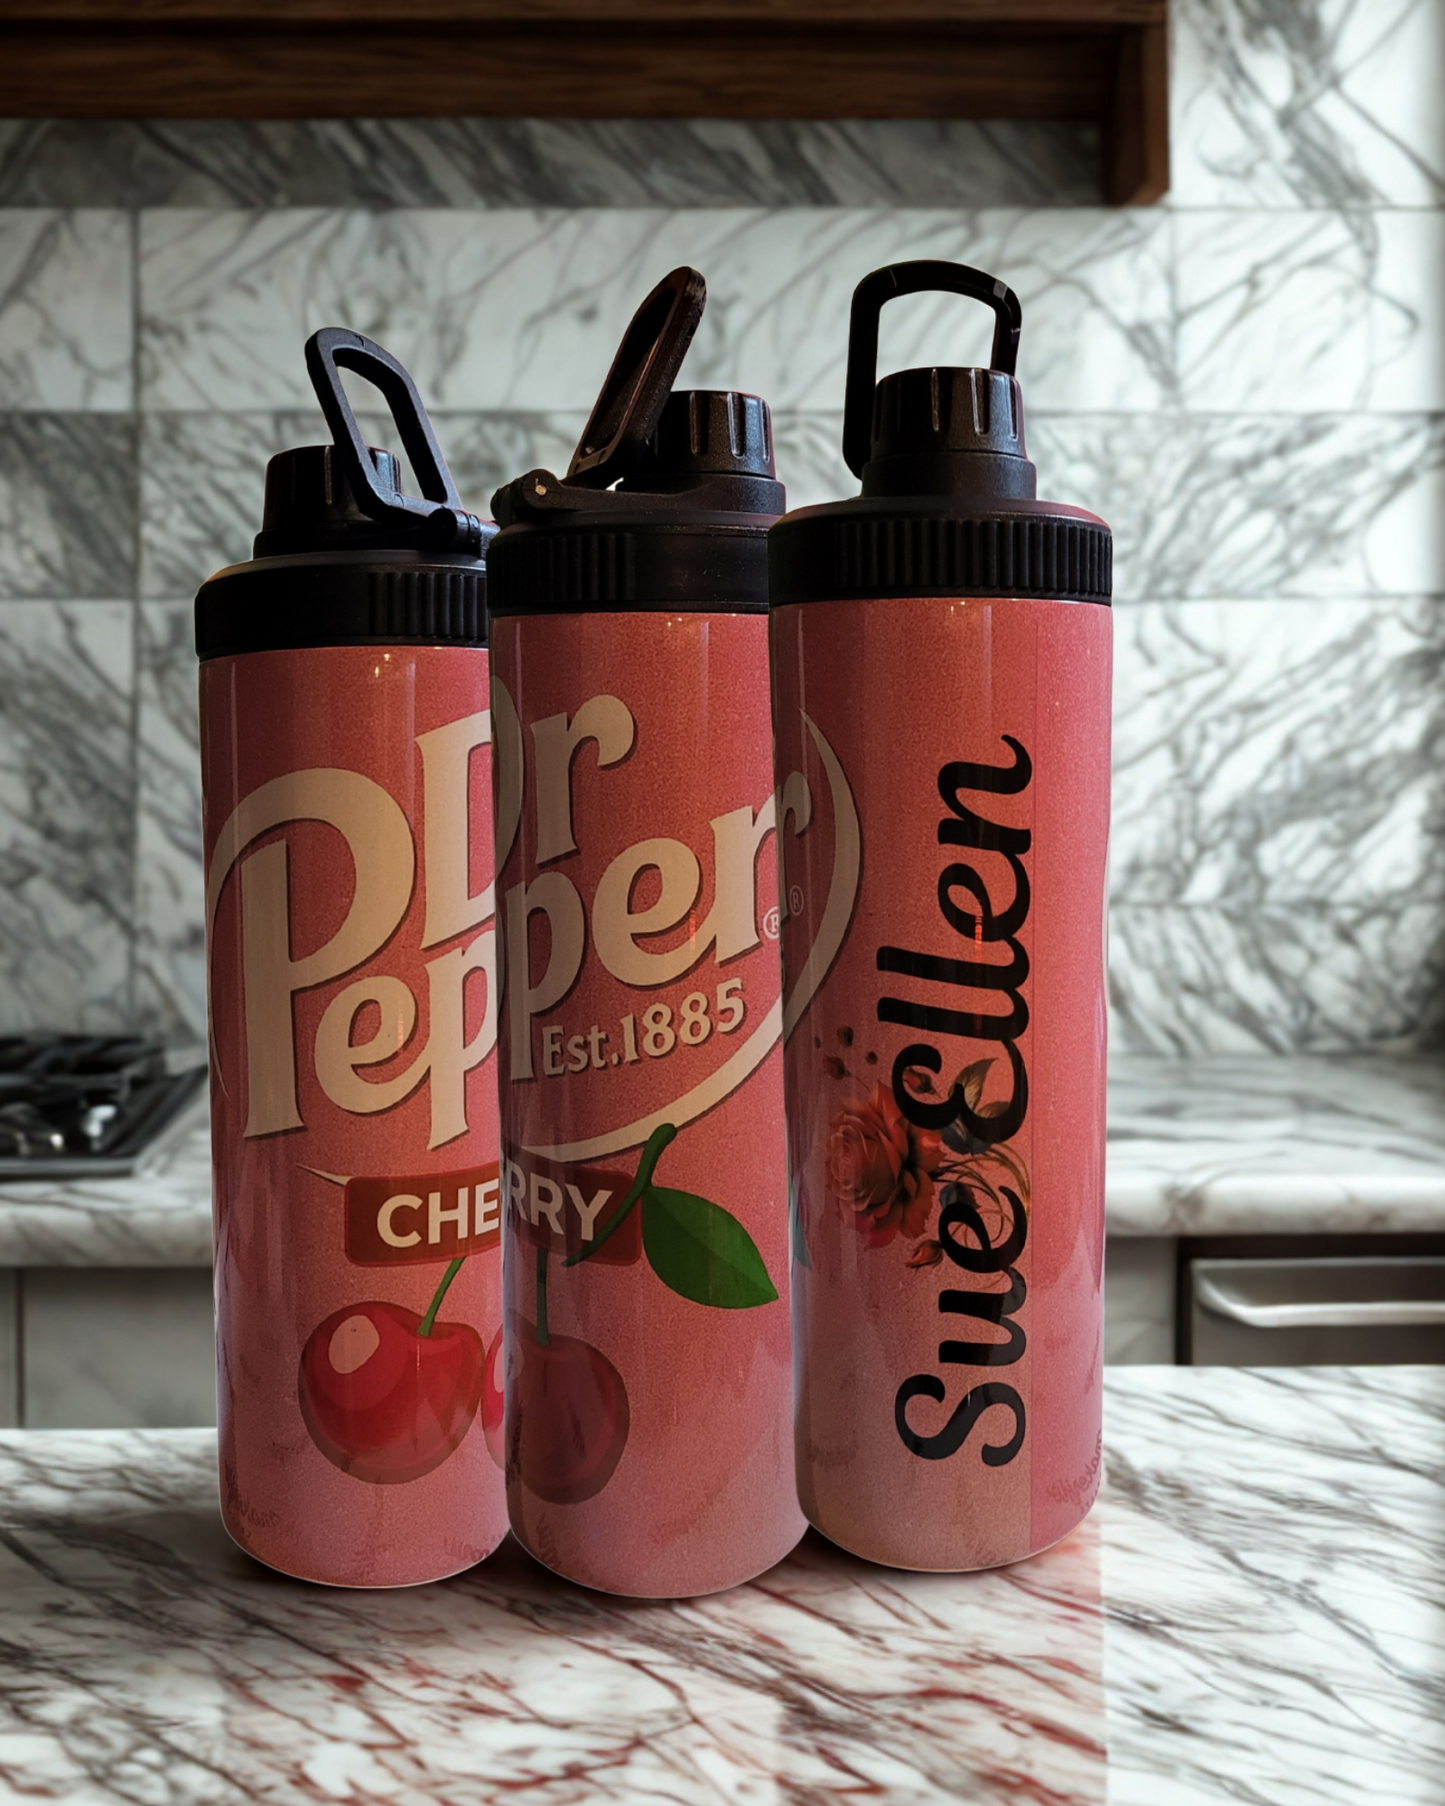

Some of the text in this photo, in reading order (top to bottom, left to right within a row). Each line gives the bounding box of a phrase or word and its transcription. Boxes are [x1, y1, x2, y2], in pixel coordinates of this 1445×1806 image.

[542, 977, 745, 1077] Est.1885
[876, 733, 1033, 1468] Sue Ellen
